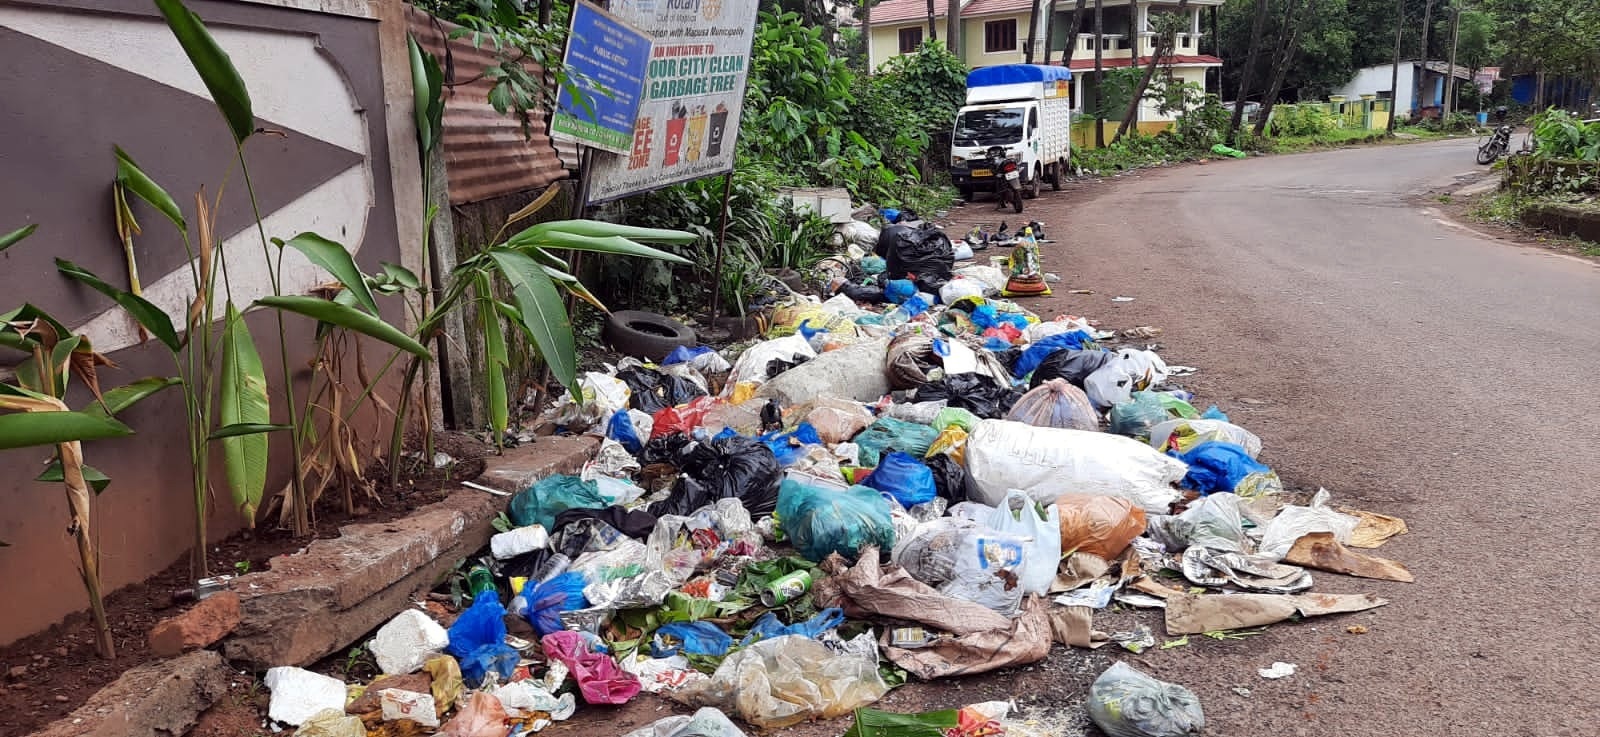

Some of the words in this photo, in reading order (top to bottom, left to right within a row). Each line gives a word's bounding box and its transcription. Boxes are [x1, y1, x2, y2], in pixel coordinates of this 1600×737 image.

[654, 46, 665, 58] AN
[666, 45, 703, 57] INITIATIVE
[705, 44, 714, 55] TO
[649, 58, 677, 79] OUR
[679, 56, 707, 77] CITY
[709, 55, 744, 74] CLEAN
[650, 77, 709, 99] GARBAGE
[710, 74, 736, 93] FREE
[628, 153, 650, 170] ZONE
